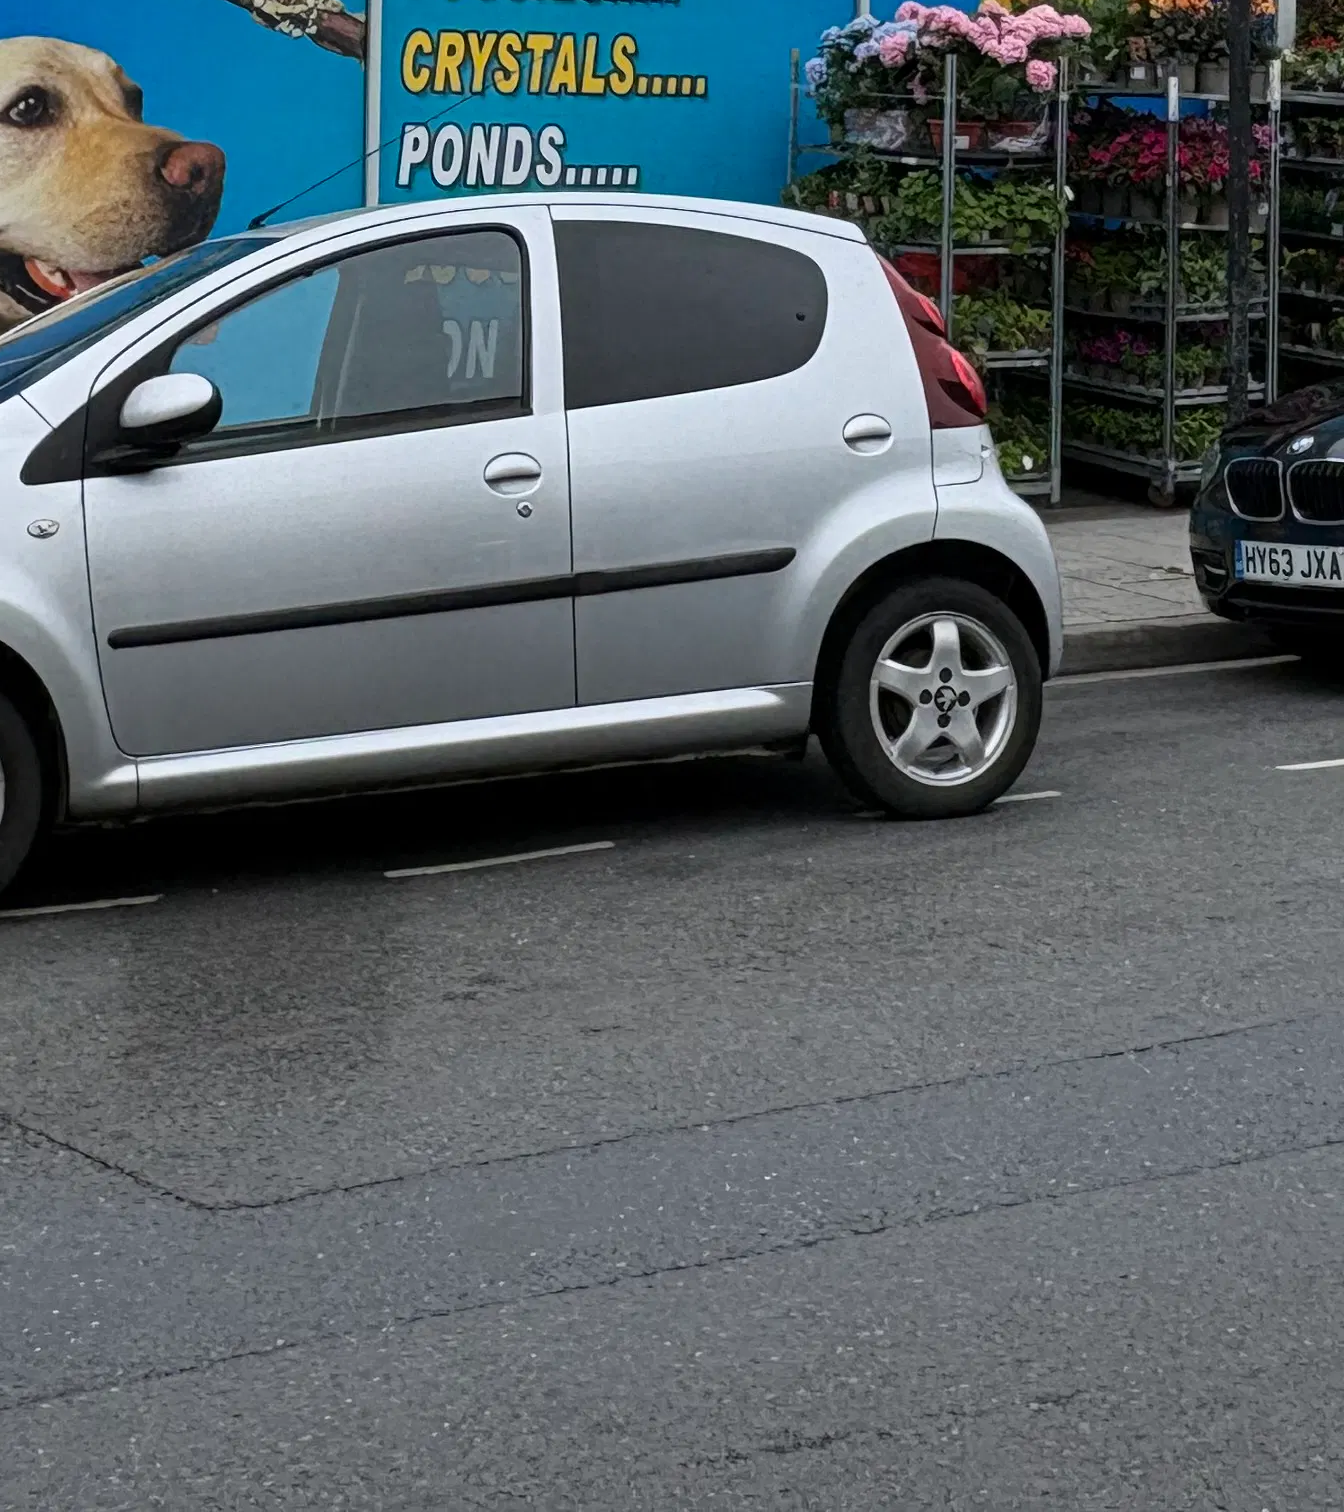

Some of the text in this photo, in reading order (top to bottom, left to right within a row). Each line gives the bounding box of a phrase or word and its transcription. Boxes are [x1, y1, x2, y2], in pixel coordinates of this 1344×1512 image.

[402, 29, 707, 96] CRYSTALS.....
[397, 123, 639, 187] PONDS.....
[1245, 545, 1342, 580] HY63 JXA
